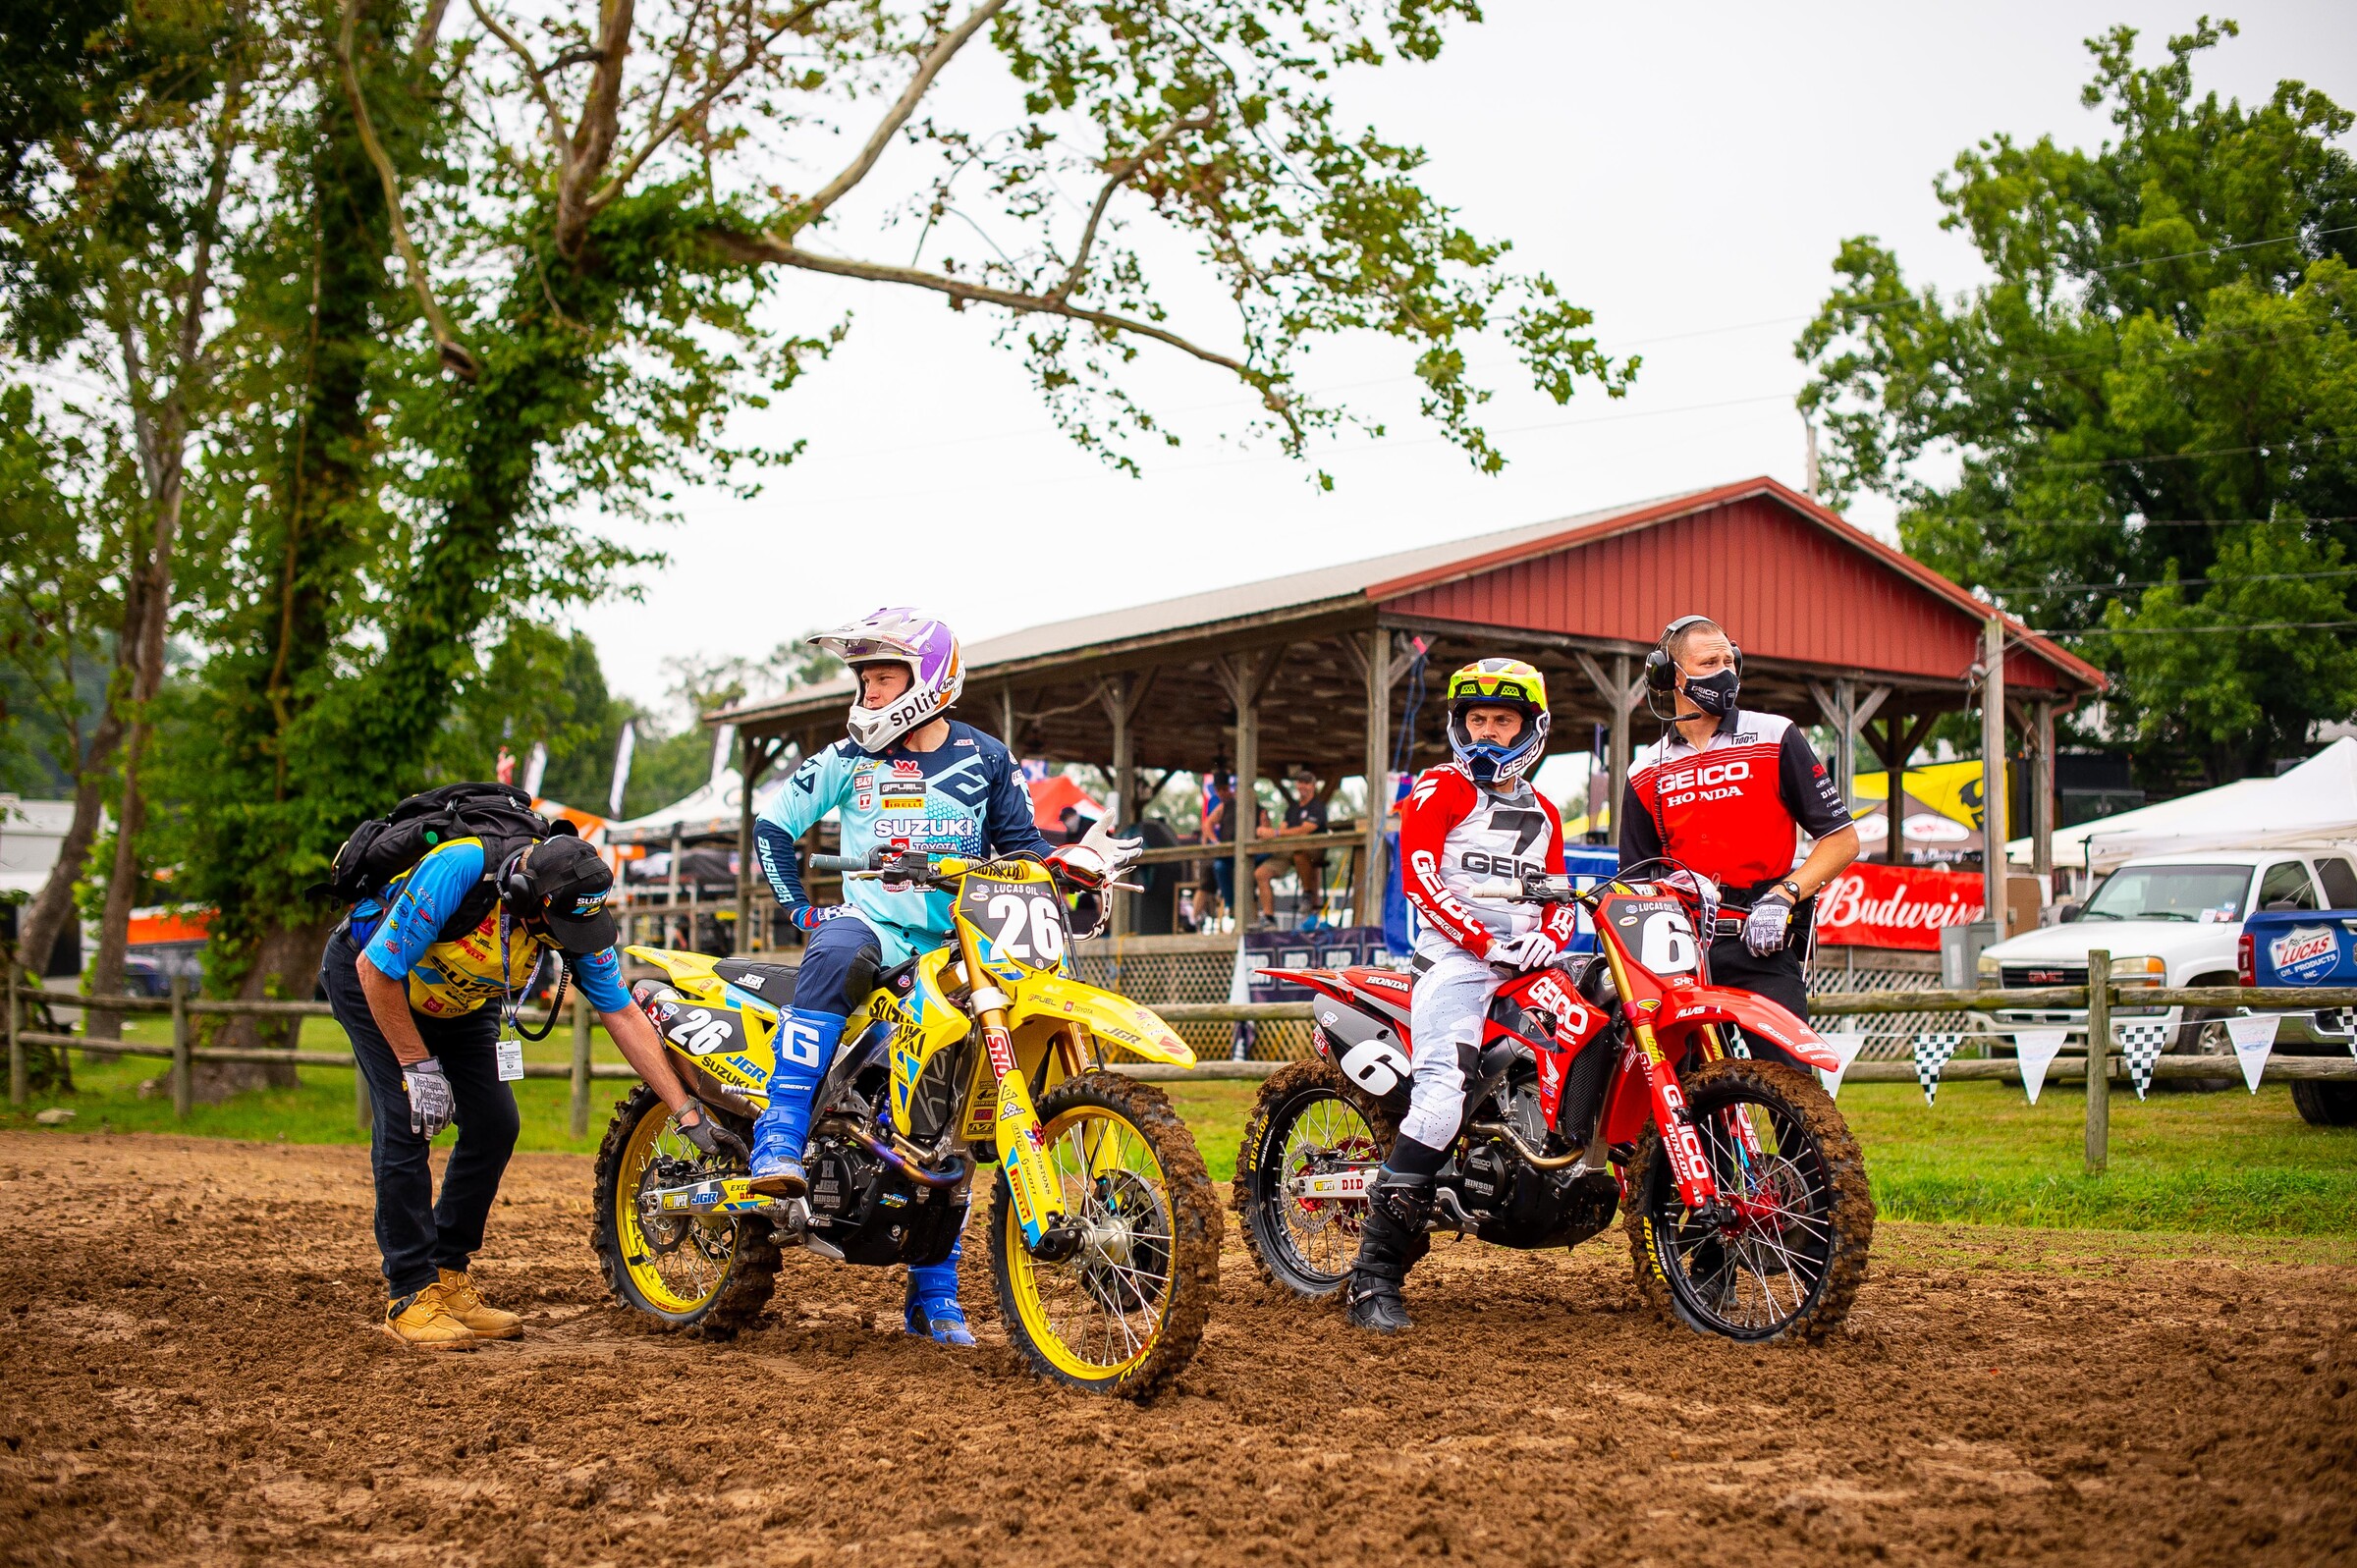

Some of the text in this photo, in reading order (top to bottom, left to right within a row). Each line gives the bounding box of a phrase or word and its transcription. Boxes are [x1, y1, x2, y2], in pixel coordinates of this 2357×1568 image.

[1691, 685, 1720, 698] GEICO
[890, 689, 939, 727] split
[1734, 735, 1756, 745] 100%
[1658, 762, 1750, 794] GEICO
[884, 798, 922, 808] PIRELLI
[1667, 785, 1744, 807] HONDA
[874, 819, 974, 837] SUZUKI
[1488, 810, 1546, 856] 7
[994, 884, 1039, 895] LUCAS OIL
[1638, 902, 1674, 912] LUCAS OIL
[987, 893, 1065, 962] 26
[1444, 924, 1459, 938] CBD
[1641, 910, 1697, 974] 6
[2280, 936, 2330, 967] LUCAS
[2029, 970, 2063, 982] GMC
[2279, 953, 2337, 978] OIL PRODUCTS
[1365, 976, 1410, 993] HONDA
[1072, 1004, 1094, 1015] TOYOTA
[1528, 976, 1589, 1035] GEICO
[668, 1008, 734, 1055] 26
[1103, 1028, 1142, 1045] JGR
[701, 1055, 751, 1089] SUZUKI
[726, 1054, 767, 1084] JGR
[986, 1034, 1013, 1089] SHO
[1340, 1039, 1411, 1096] 6
[1248, 1113, 1270, 1172] DUNLOP
[1665, 1123, 1692, 1181] DUNLOP
[1035, 1154, 1052, 1195] PISTONS
[1342, 1178, 1364, 1190] DID
[691, 1191, 718, 1205] JGR
[882, 1193, 908, 1204] SUZUKI
[1010, 1168, 1031, 1219] PIRELLI
